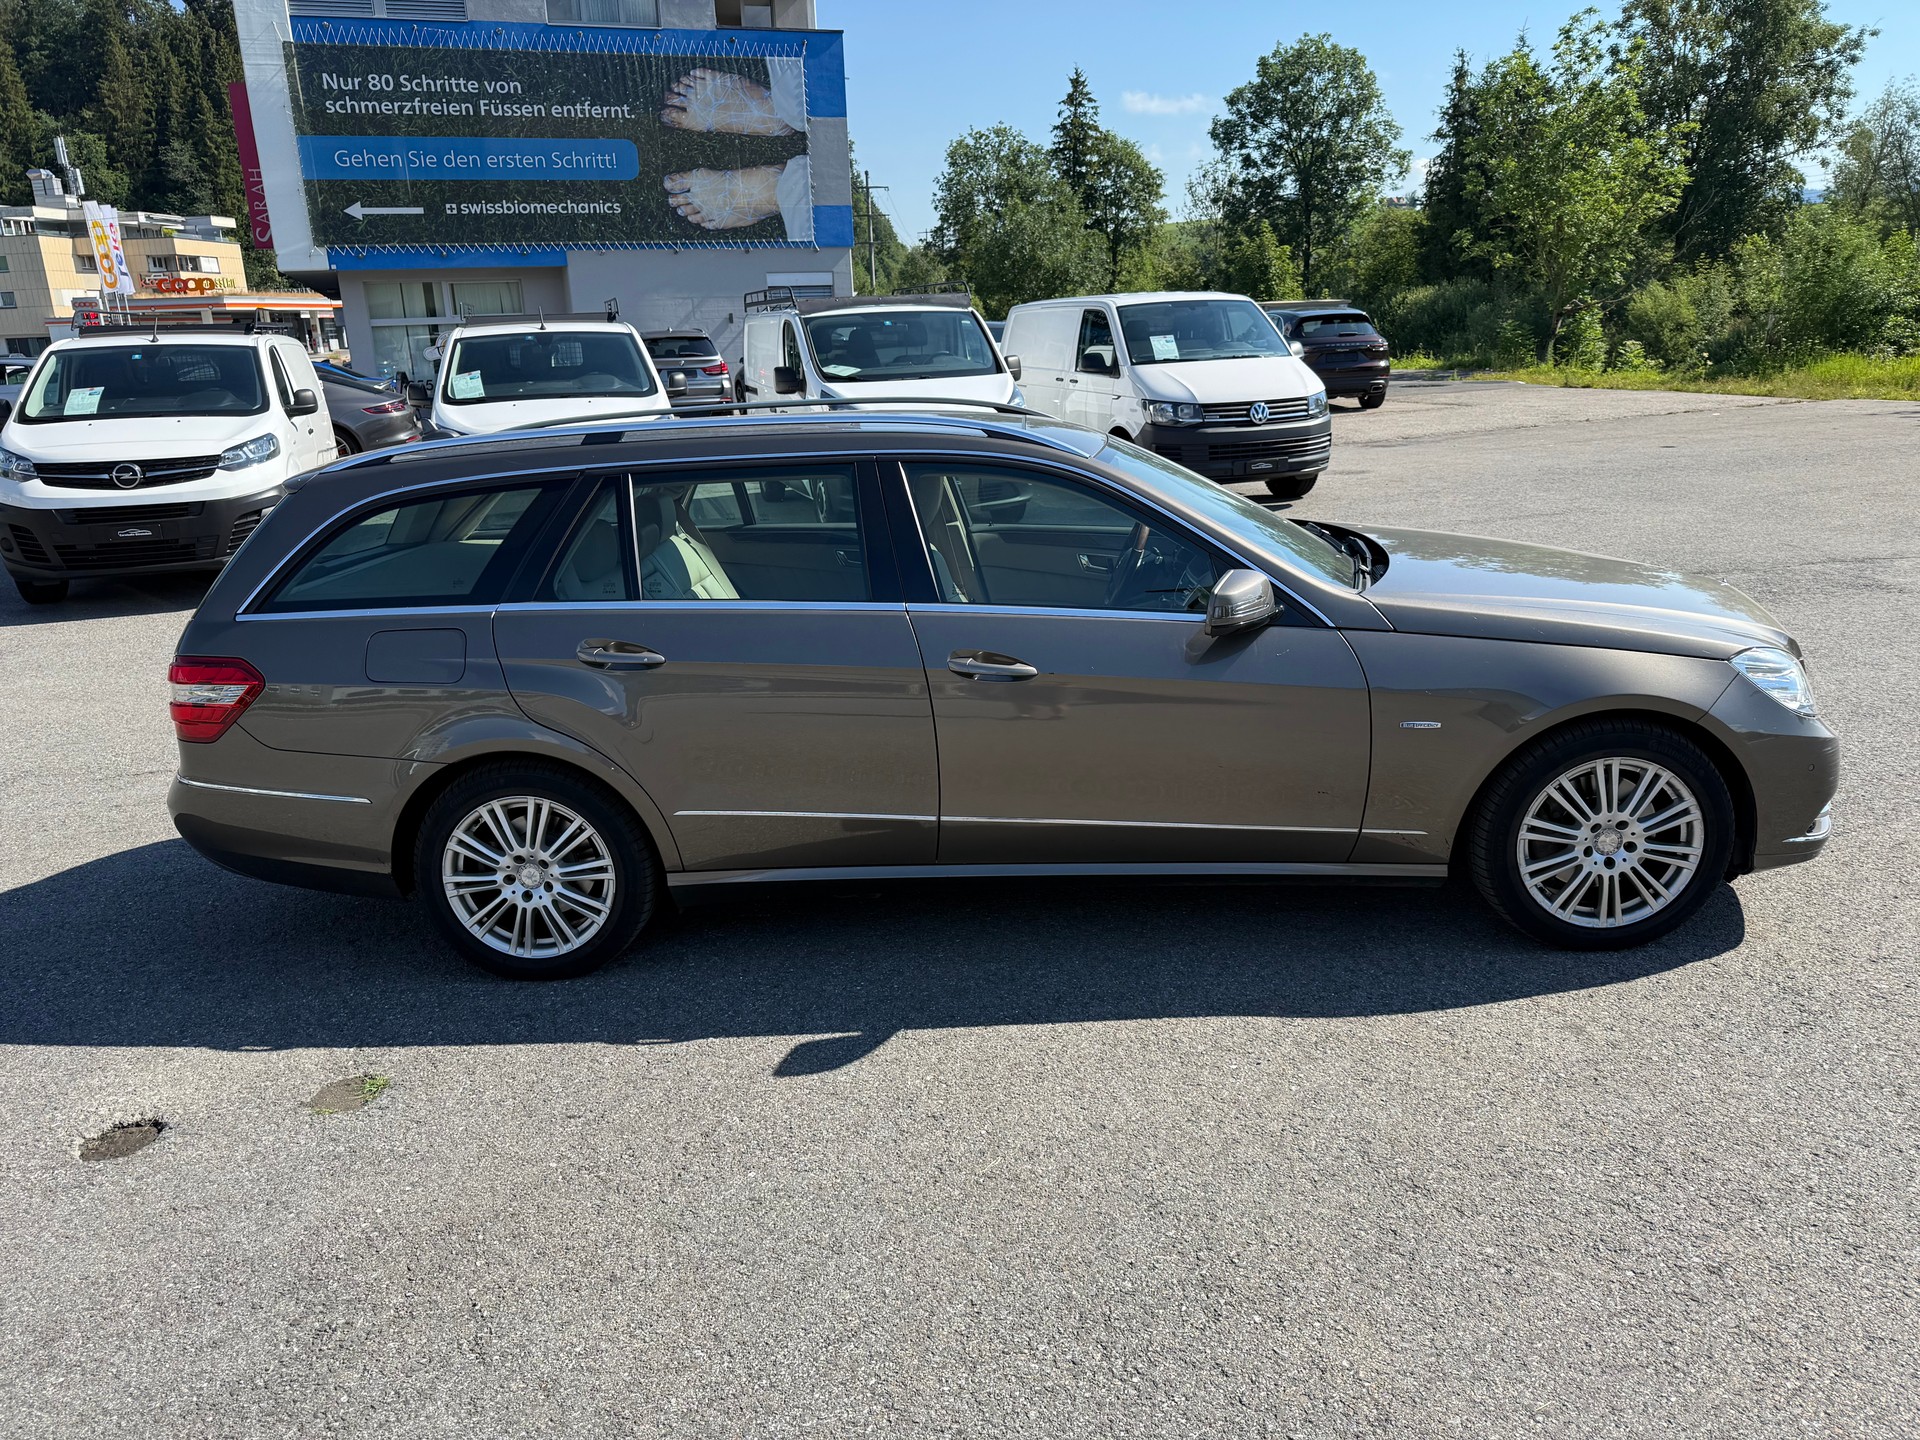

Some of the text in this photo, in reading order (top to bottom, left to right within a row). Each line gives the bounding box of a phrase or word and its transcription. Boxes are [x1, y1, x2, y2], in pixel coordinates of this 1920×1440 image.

[321, 72, 522, 94] Nur 80 Schritte von
[325, 95, 636, 119] schmerzfreien Füssen entfernt.
[334, 148, 617, 169] Gehen Sie den ersten Schritt!
[248, 168, 272, 242] SARAH
[460, 199, 622, 215] swissbiomechanics
[92, 220, 118, 289] coop
[157, 277, 215, 295] coop
[73, 301, 98, 309] coop
